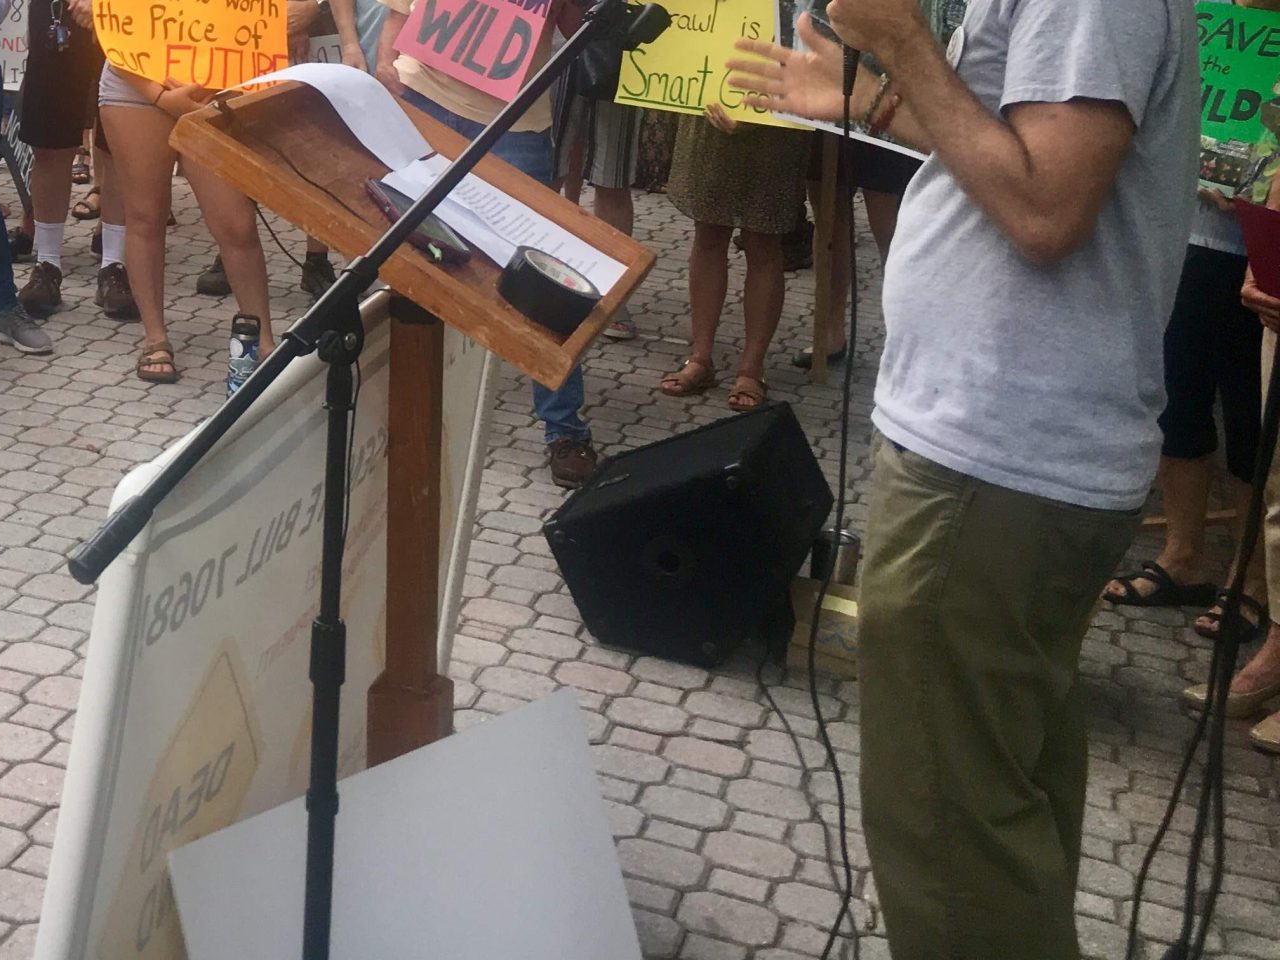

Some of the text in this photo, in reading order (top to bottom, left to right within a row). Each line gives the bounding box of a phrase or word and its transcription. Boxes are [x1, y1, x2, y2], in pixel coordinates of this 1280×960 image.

[96, 2, 268, 50] the Price of
[741, 16, 761, 40] is
[1196, 12, 1280, 58] SAVE
[622, 48, 713, 106] Smart
[1202, 55, 1231, 75] the
[1200, 78, 1262, 123] ILD
